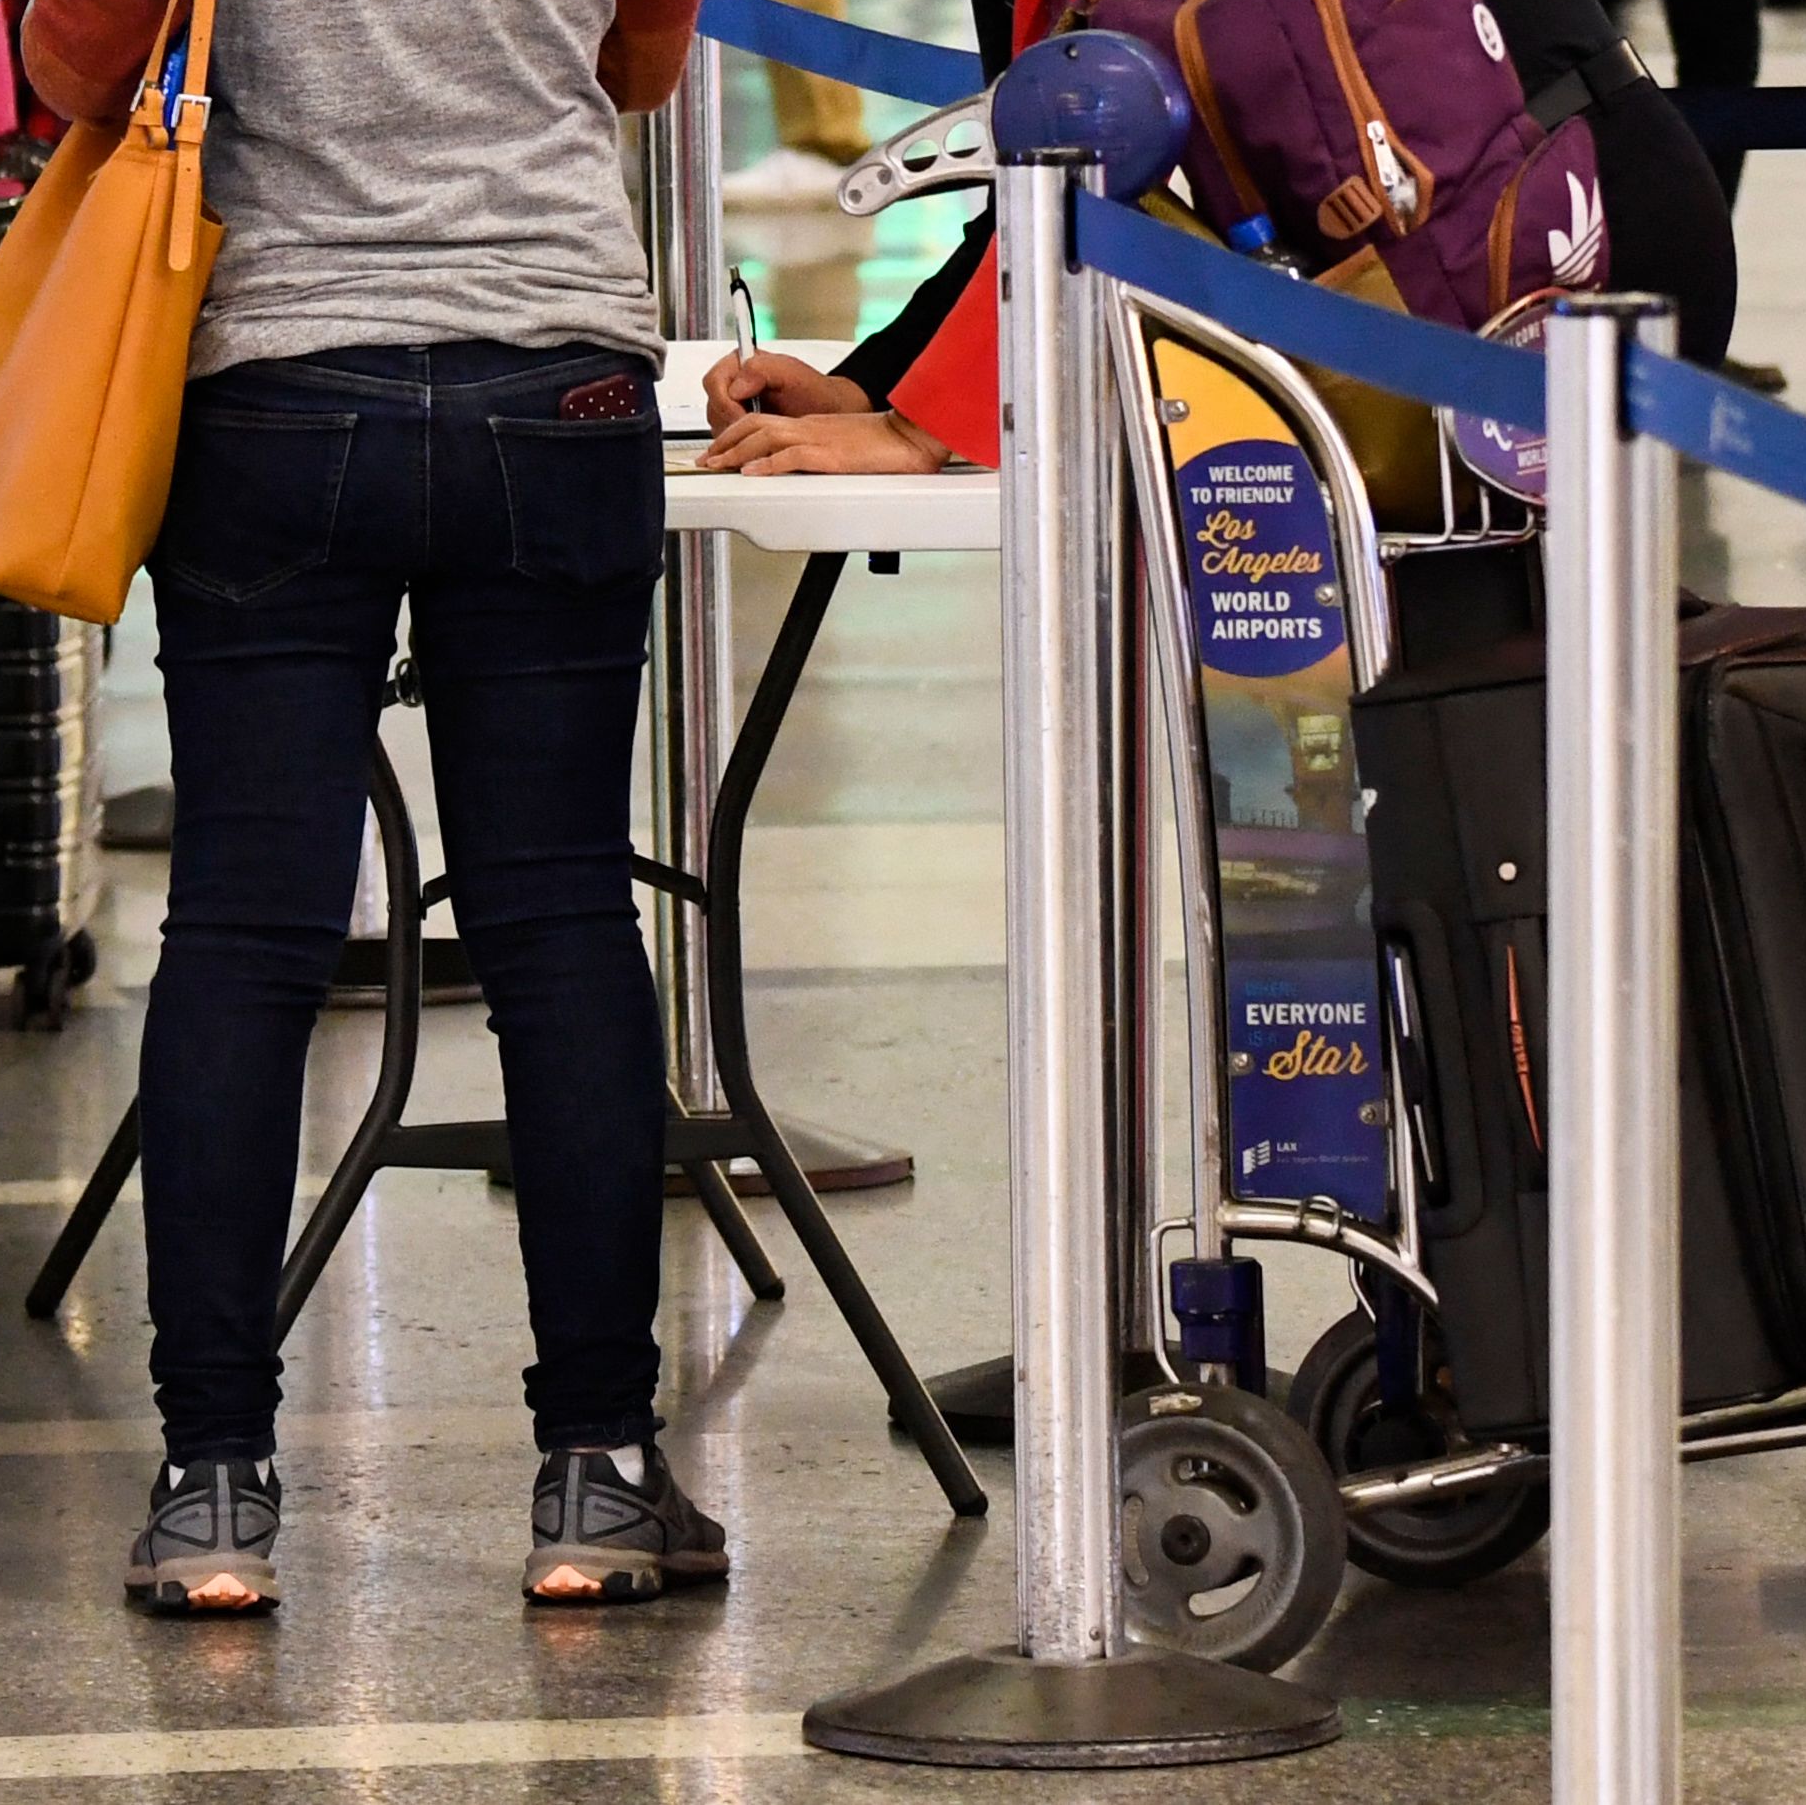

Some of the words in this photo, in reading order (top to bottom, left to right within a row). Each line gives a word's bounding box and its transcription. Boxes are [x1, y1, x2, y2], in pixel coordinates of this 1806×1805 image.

[1208, 464, 1294, 483] WELCOME
[1190, 487, 1212, 504] TO
[1215, 486, 1295, 505] FRIENDLY
[1196, 509, 1256, 549] Los
[1201, 545, 1323, 584] Angeles
[1211, 591, 1291, 613] WORLD
[1211, 617, 1323, 640] AIRPORTS
[1246, 1002, 1367, 1026] EVERYONE
[1261, 1029, 1369, 1081] Star
[1276, 1142, 1298, 1153] LAX
